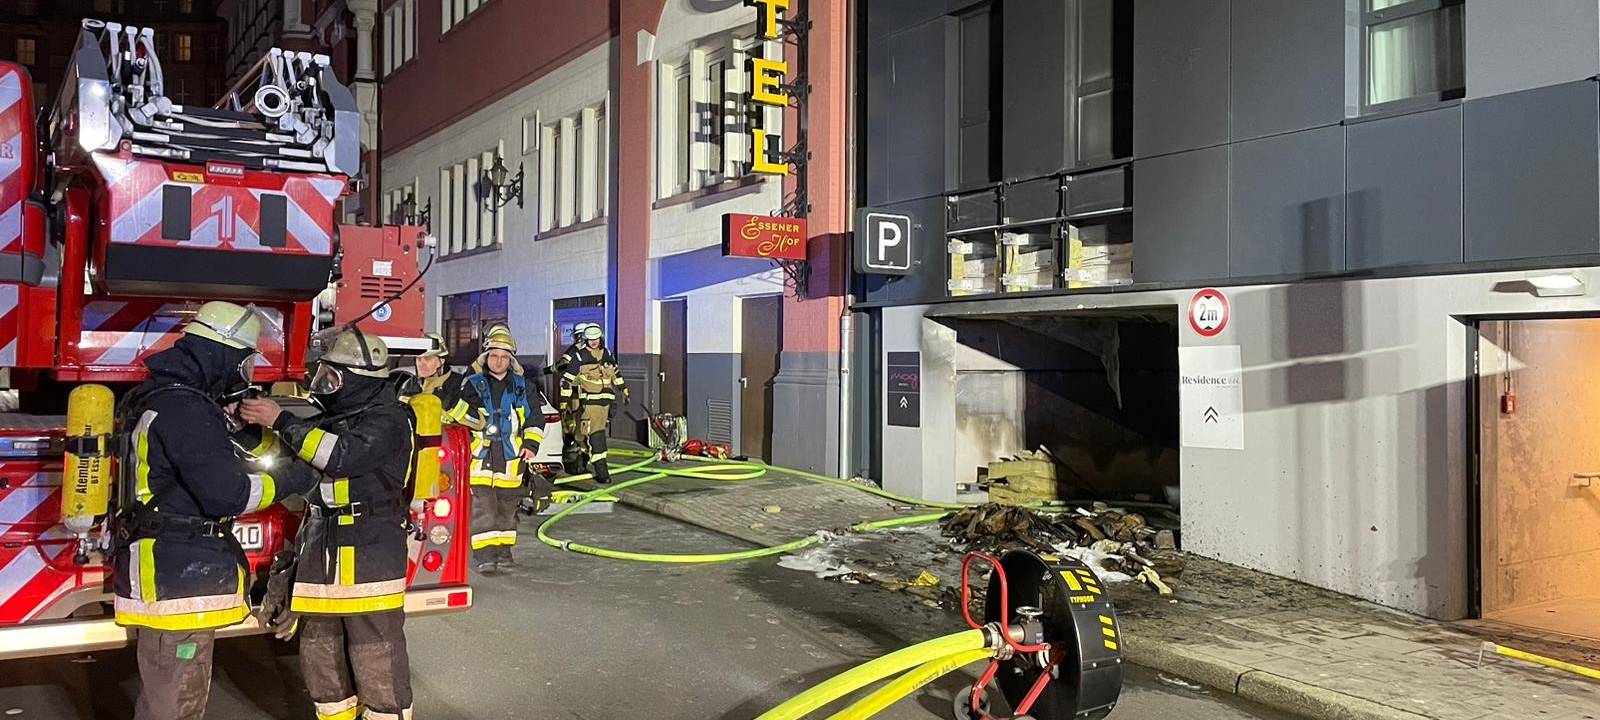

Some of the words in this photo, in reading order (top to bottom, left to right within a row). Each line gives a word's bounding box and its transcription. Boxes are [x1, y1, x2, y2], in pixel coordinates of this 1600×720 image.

[752, 0, 789, 176] TEL
[211, 195, 233, 239] 1
[879, 221, 901, 261] P
[1200, 303, 1218, 321] 2m
[1182, 376, 1226, 385] Residence
[235, 526, 259, 545] 10
